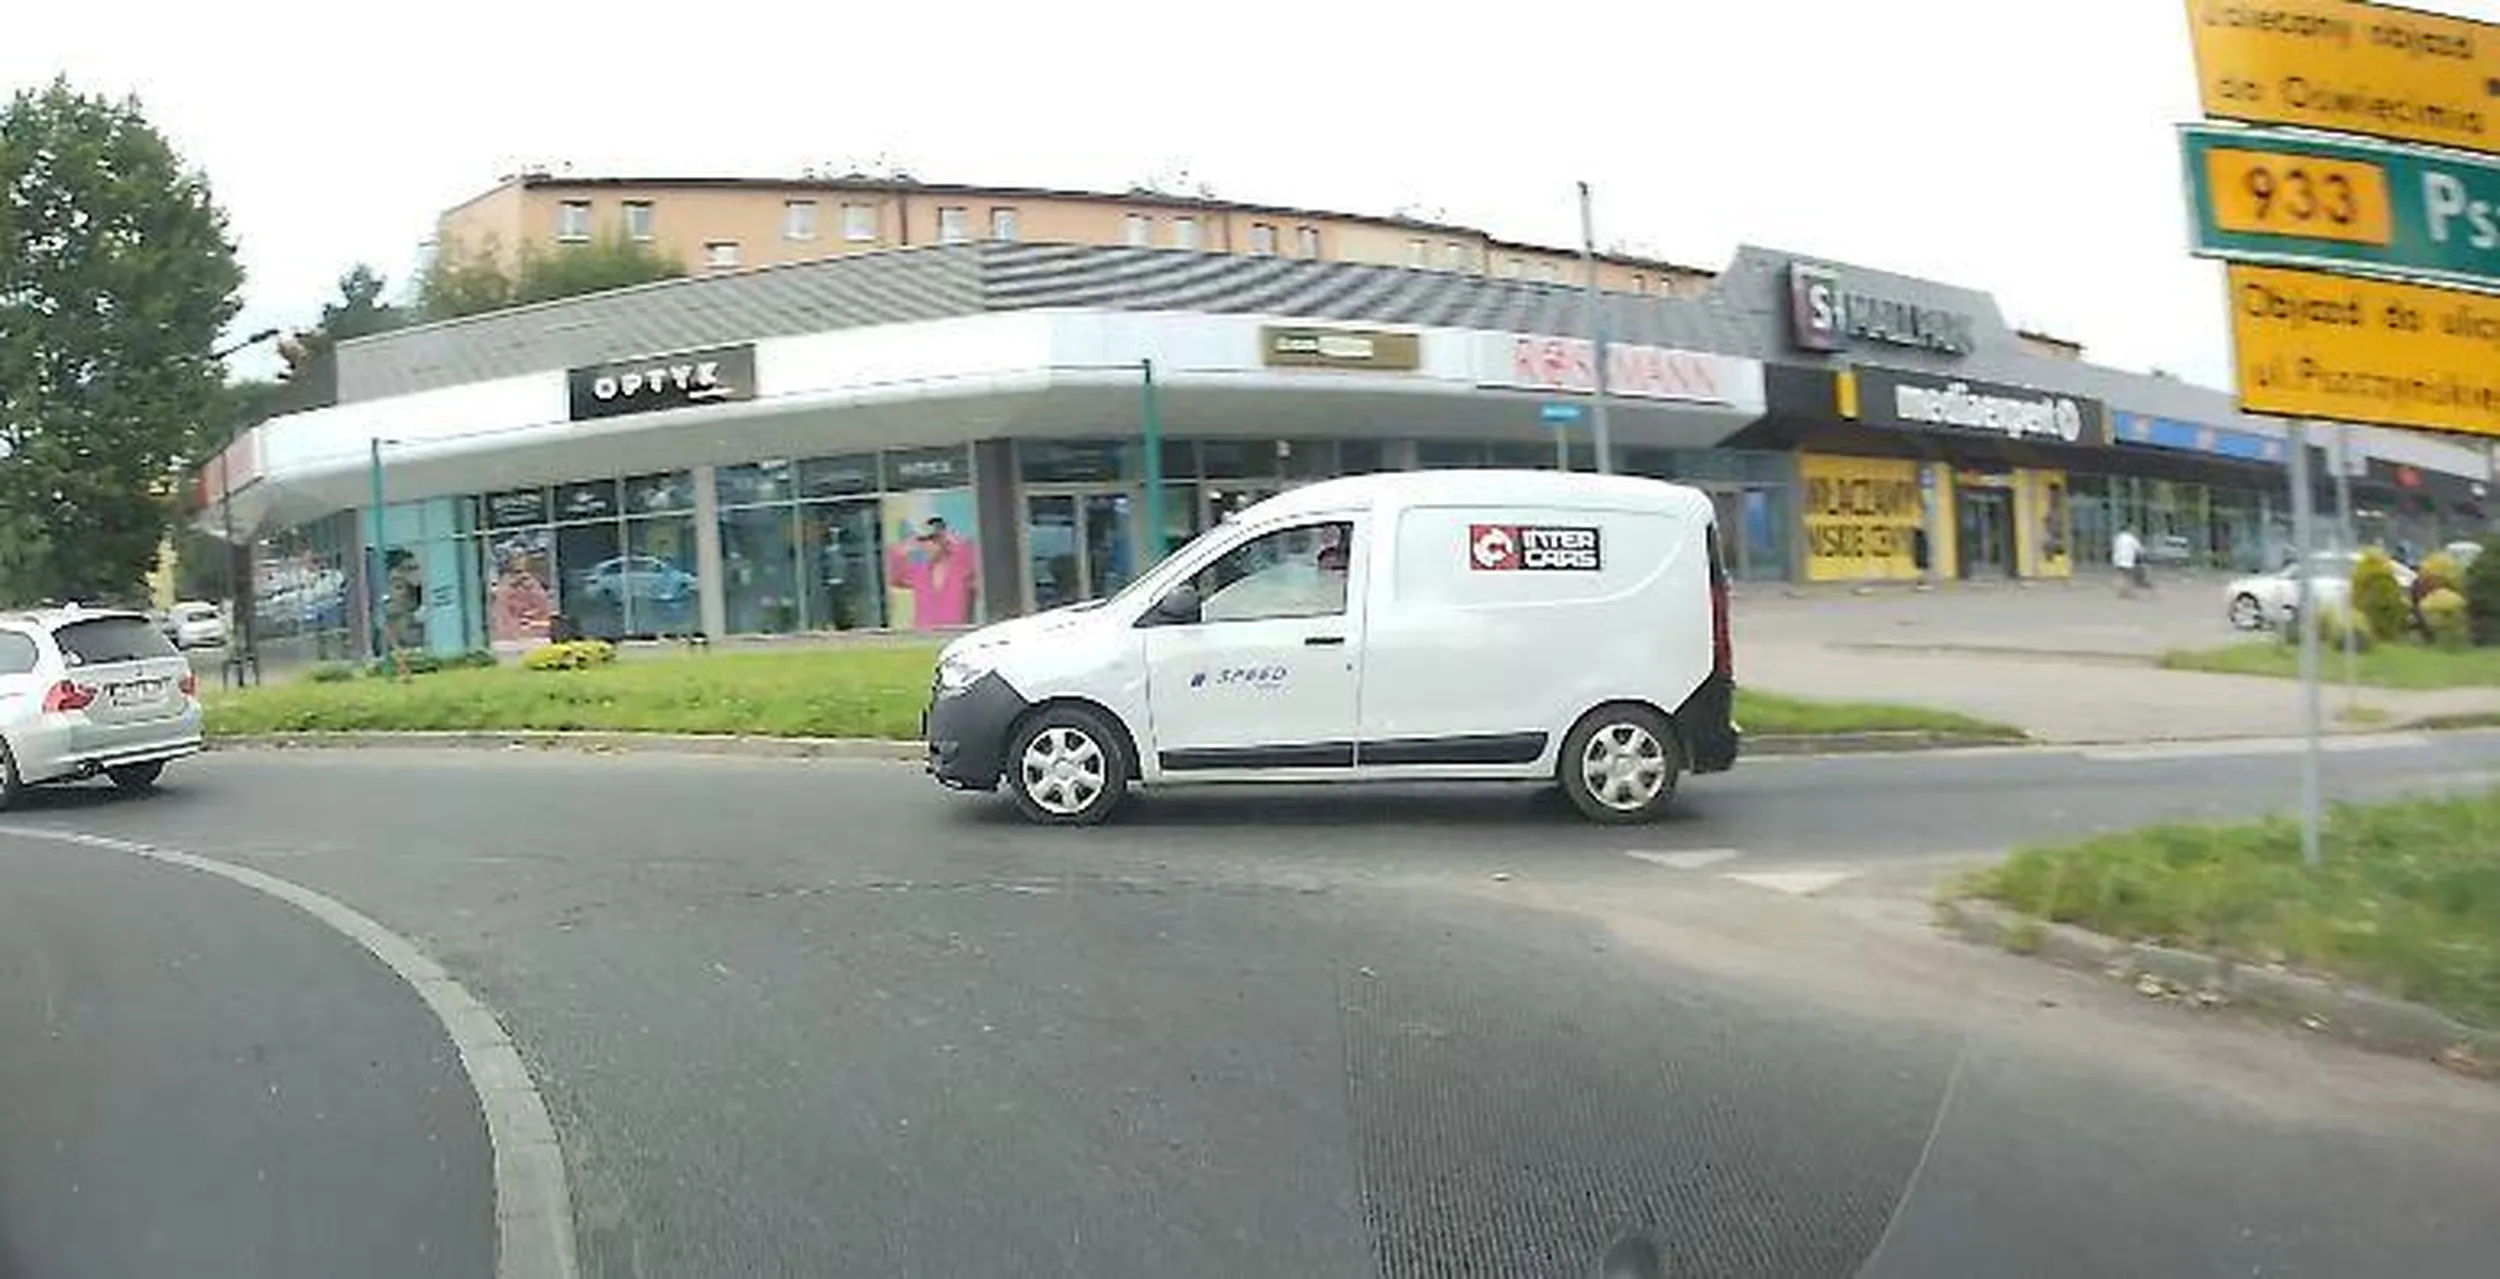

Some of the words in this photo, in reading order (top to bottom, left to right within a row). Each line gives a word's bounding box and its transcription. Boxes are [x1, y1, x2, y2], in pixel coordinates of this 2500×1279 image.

[2244, 166, 2358, 225] 933
[2422, 170, 2500, 249] Ps
[594, 362, 719, 400] OPTYK
[1512, 338, 1717, 392] ROSMANN
[1521, 530, 1597, 549] INTER
[1523, 549, 1598, 568] CARS
